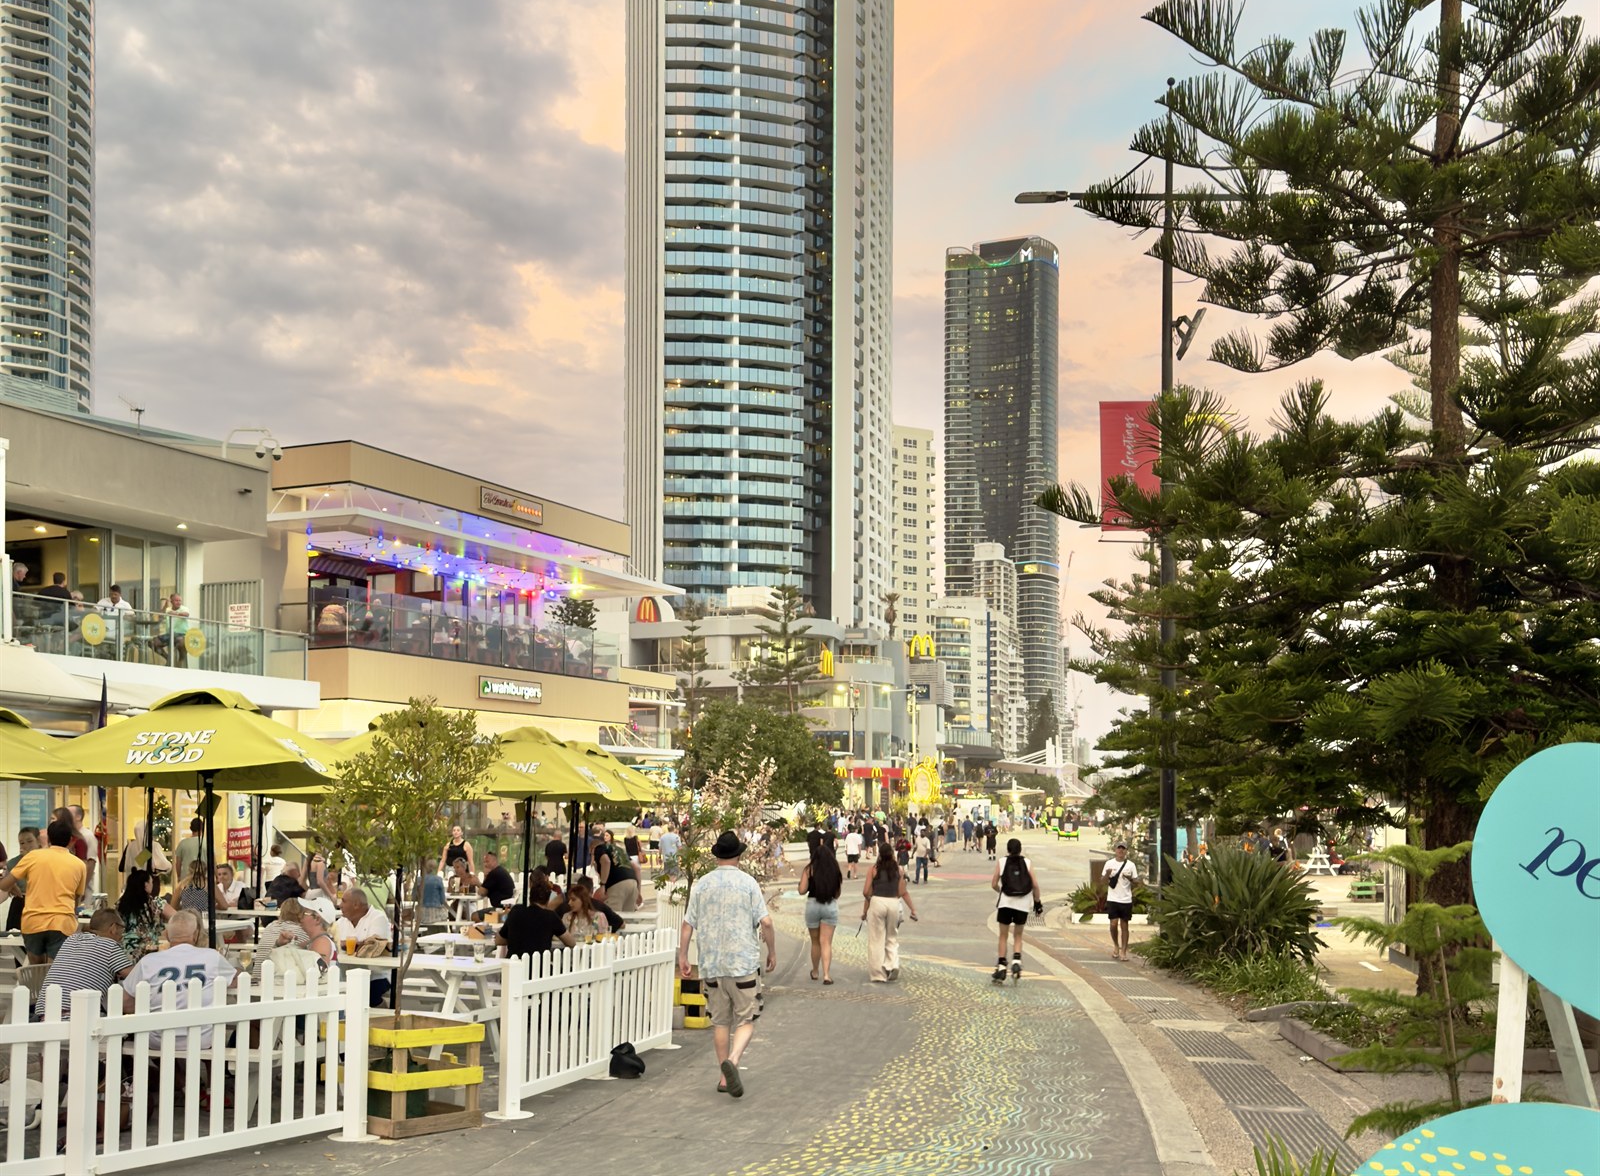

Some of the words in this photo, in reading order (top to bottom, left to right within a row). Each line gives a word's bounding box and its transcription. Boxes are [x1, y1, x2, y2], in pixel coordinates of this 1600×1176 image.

[1120, 414, 1140, 468] Greetings
[492, 681, 541, 699] wahlburgers
[131, 729, 217, 746] STONE
[126, 748, 205, 765] WOOD
[1518, 827, 1600, 899] pe
[157, 964, 206, 993] 25
